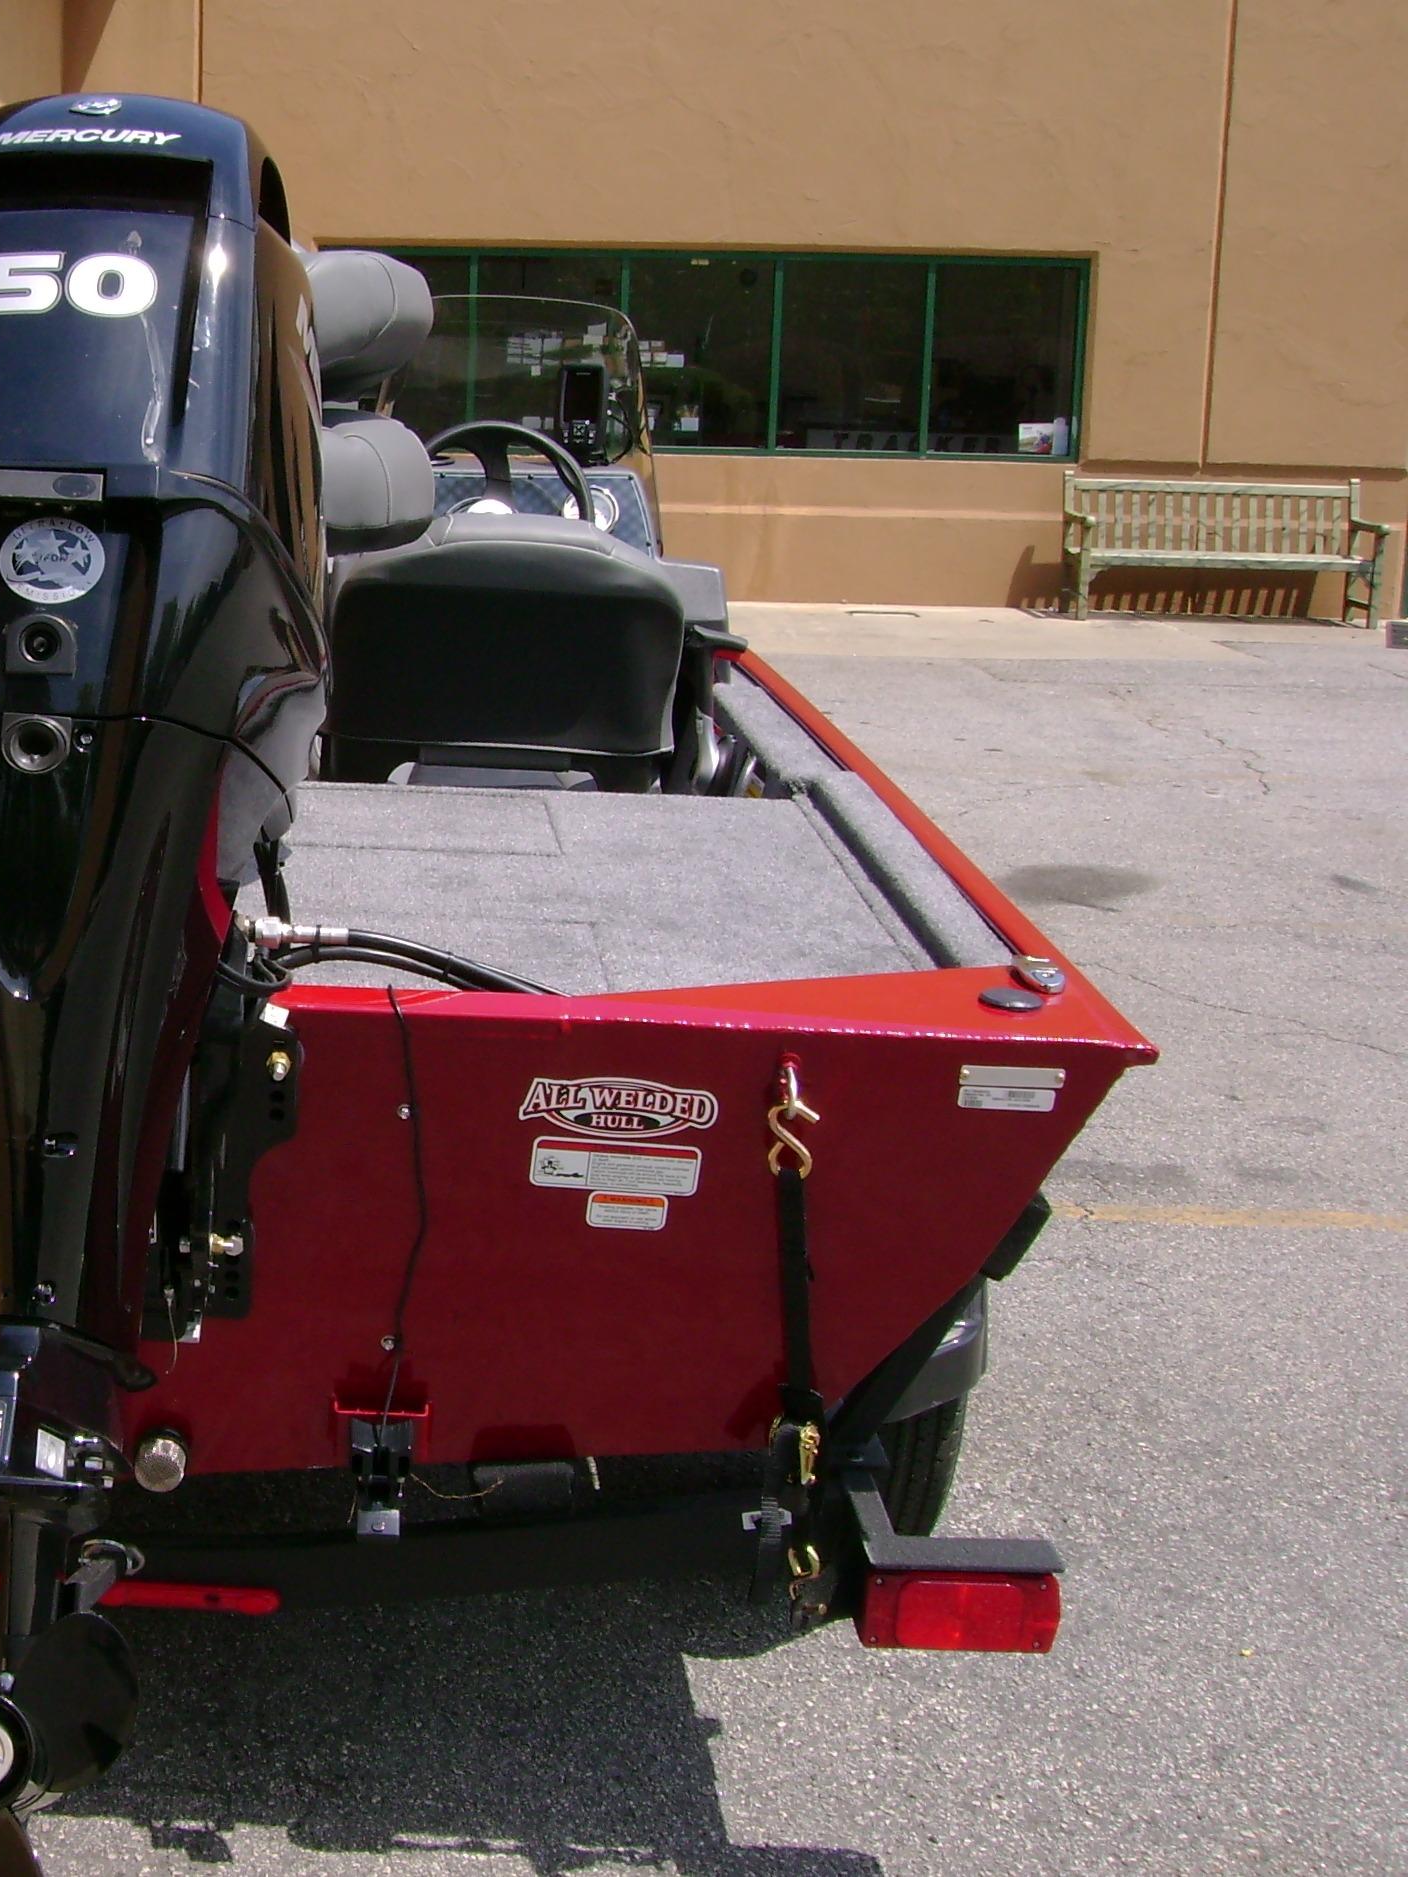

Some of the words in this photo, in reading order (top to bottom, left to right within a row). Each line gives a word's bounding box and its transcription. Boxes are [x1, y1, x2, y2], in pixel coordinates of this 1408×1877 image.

[524, 1082, 584, 1113] ALL
[589, 1086, 713, 1123] WELDED
[590, 1113, 644, 1130] HULL
